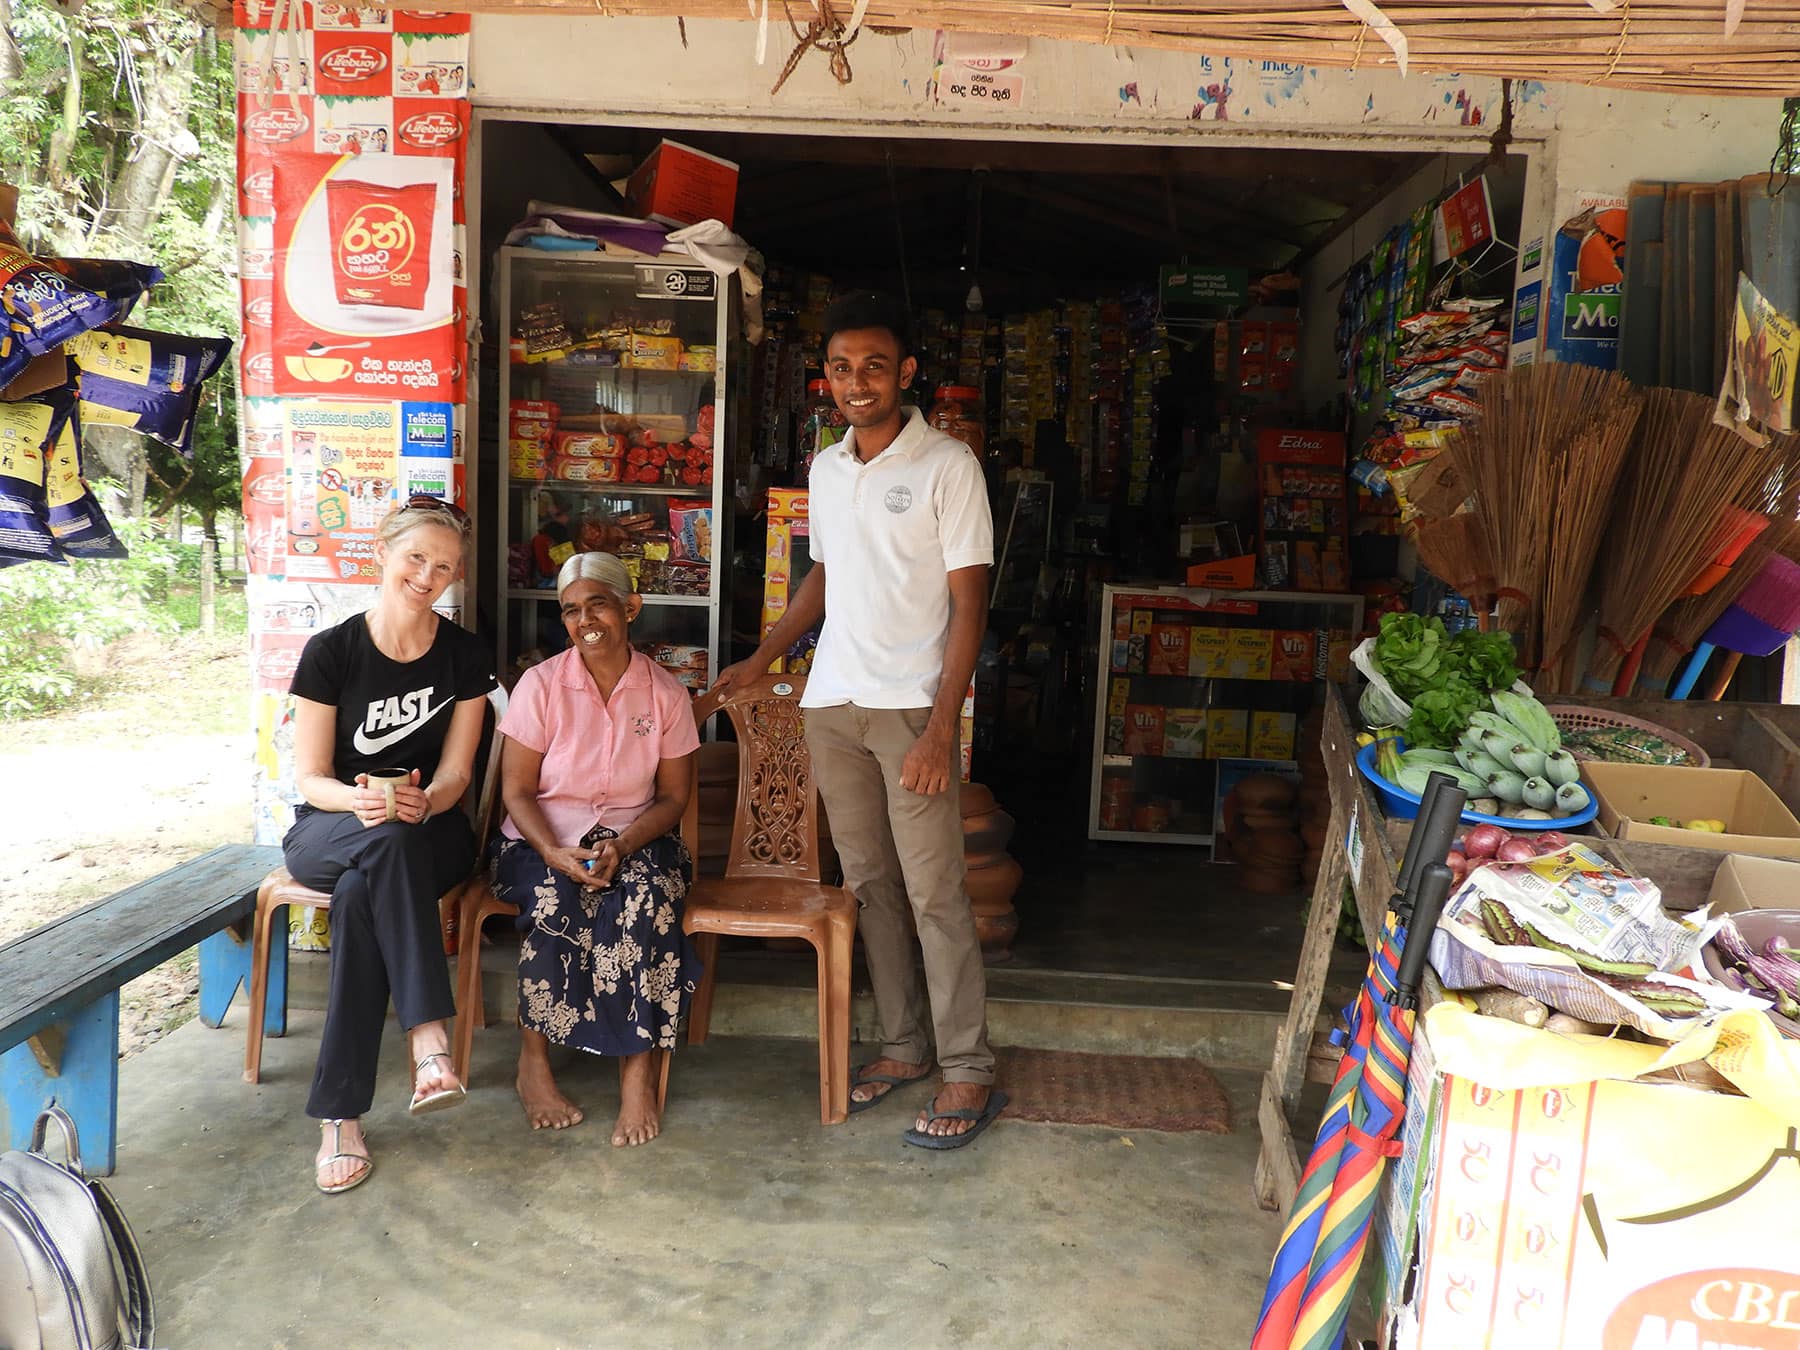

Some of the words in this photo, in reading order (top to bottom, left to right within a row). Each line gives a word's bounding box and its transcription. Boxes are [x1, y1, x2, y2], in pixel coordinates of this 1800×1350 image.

[327, 56, 377, 69] Lifebuoy
[406, 122, 457, 136] Lifebuoy
[343, 211, 407, 252] රන්
[407, 413, 447, 424] Telecom
[1278, 434, 1323, 449] Edna
[408, 469, 447, 481] Telecom
[1315, 629, 1329, 680] Nestomalt
[365, 686, 434, 733] FAST
